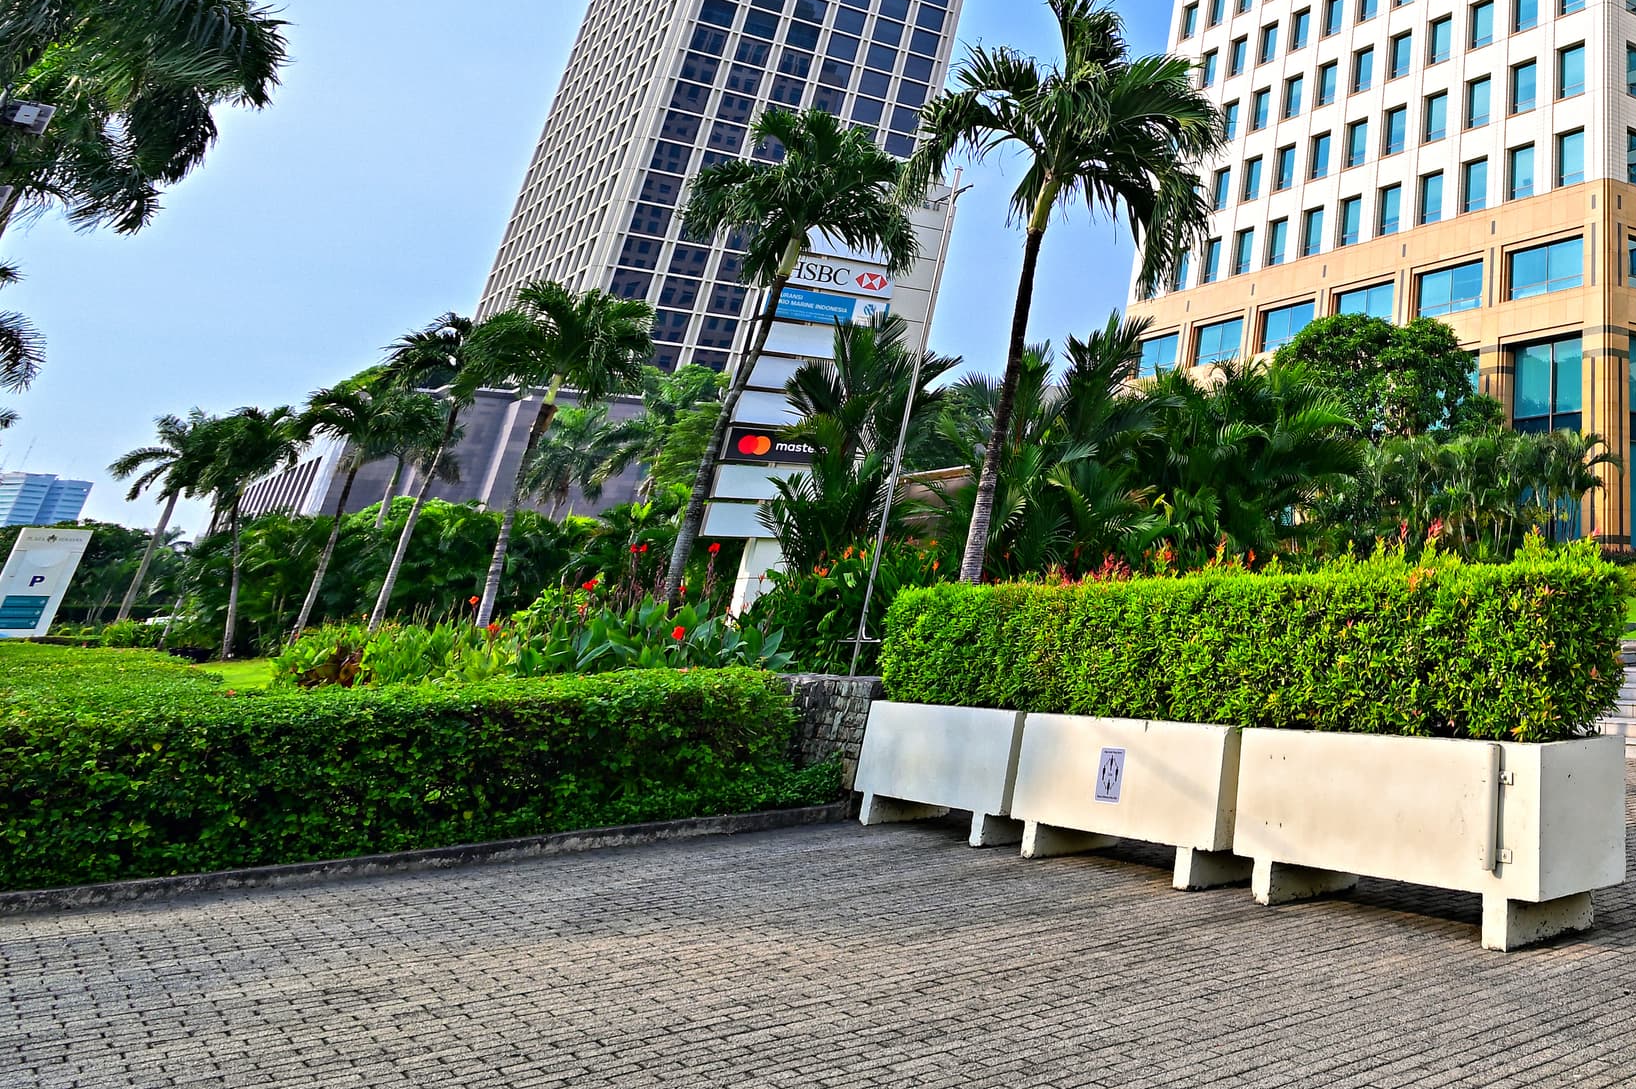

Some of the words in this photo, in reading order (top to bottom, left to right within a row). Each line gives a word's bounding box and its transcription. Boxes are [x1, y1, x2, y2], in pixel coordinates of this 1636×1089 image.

[781, 292, 803, 300] URANSI
[790, 300, 814, 308] MARINE
[815, 303, 848, 313] INDONESIA
[775, 442, 829, 454] maste
[29, 575, 45, 587] P
